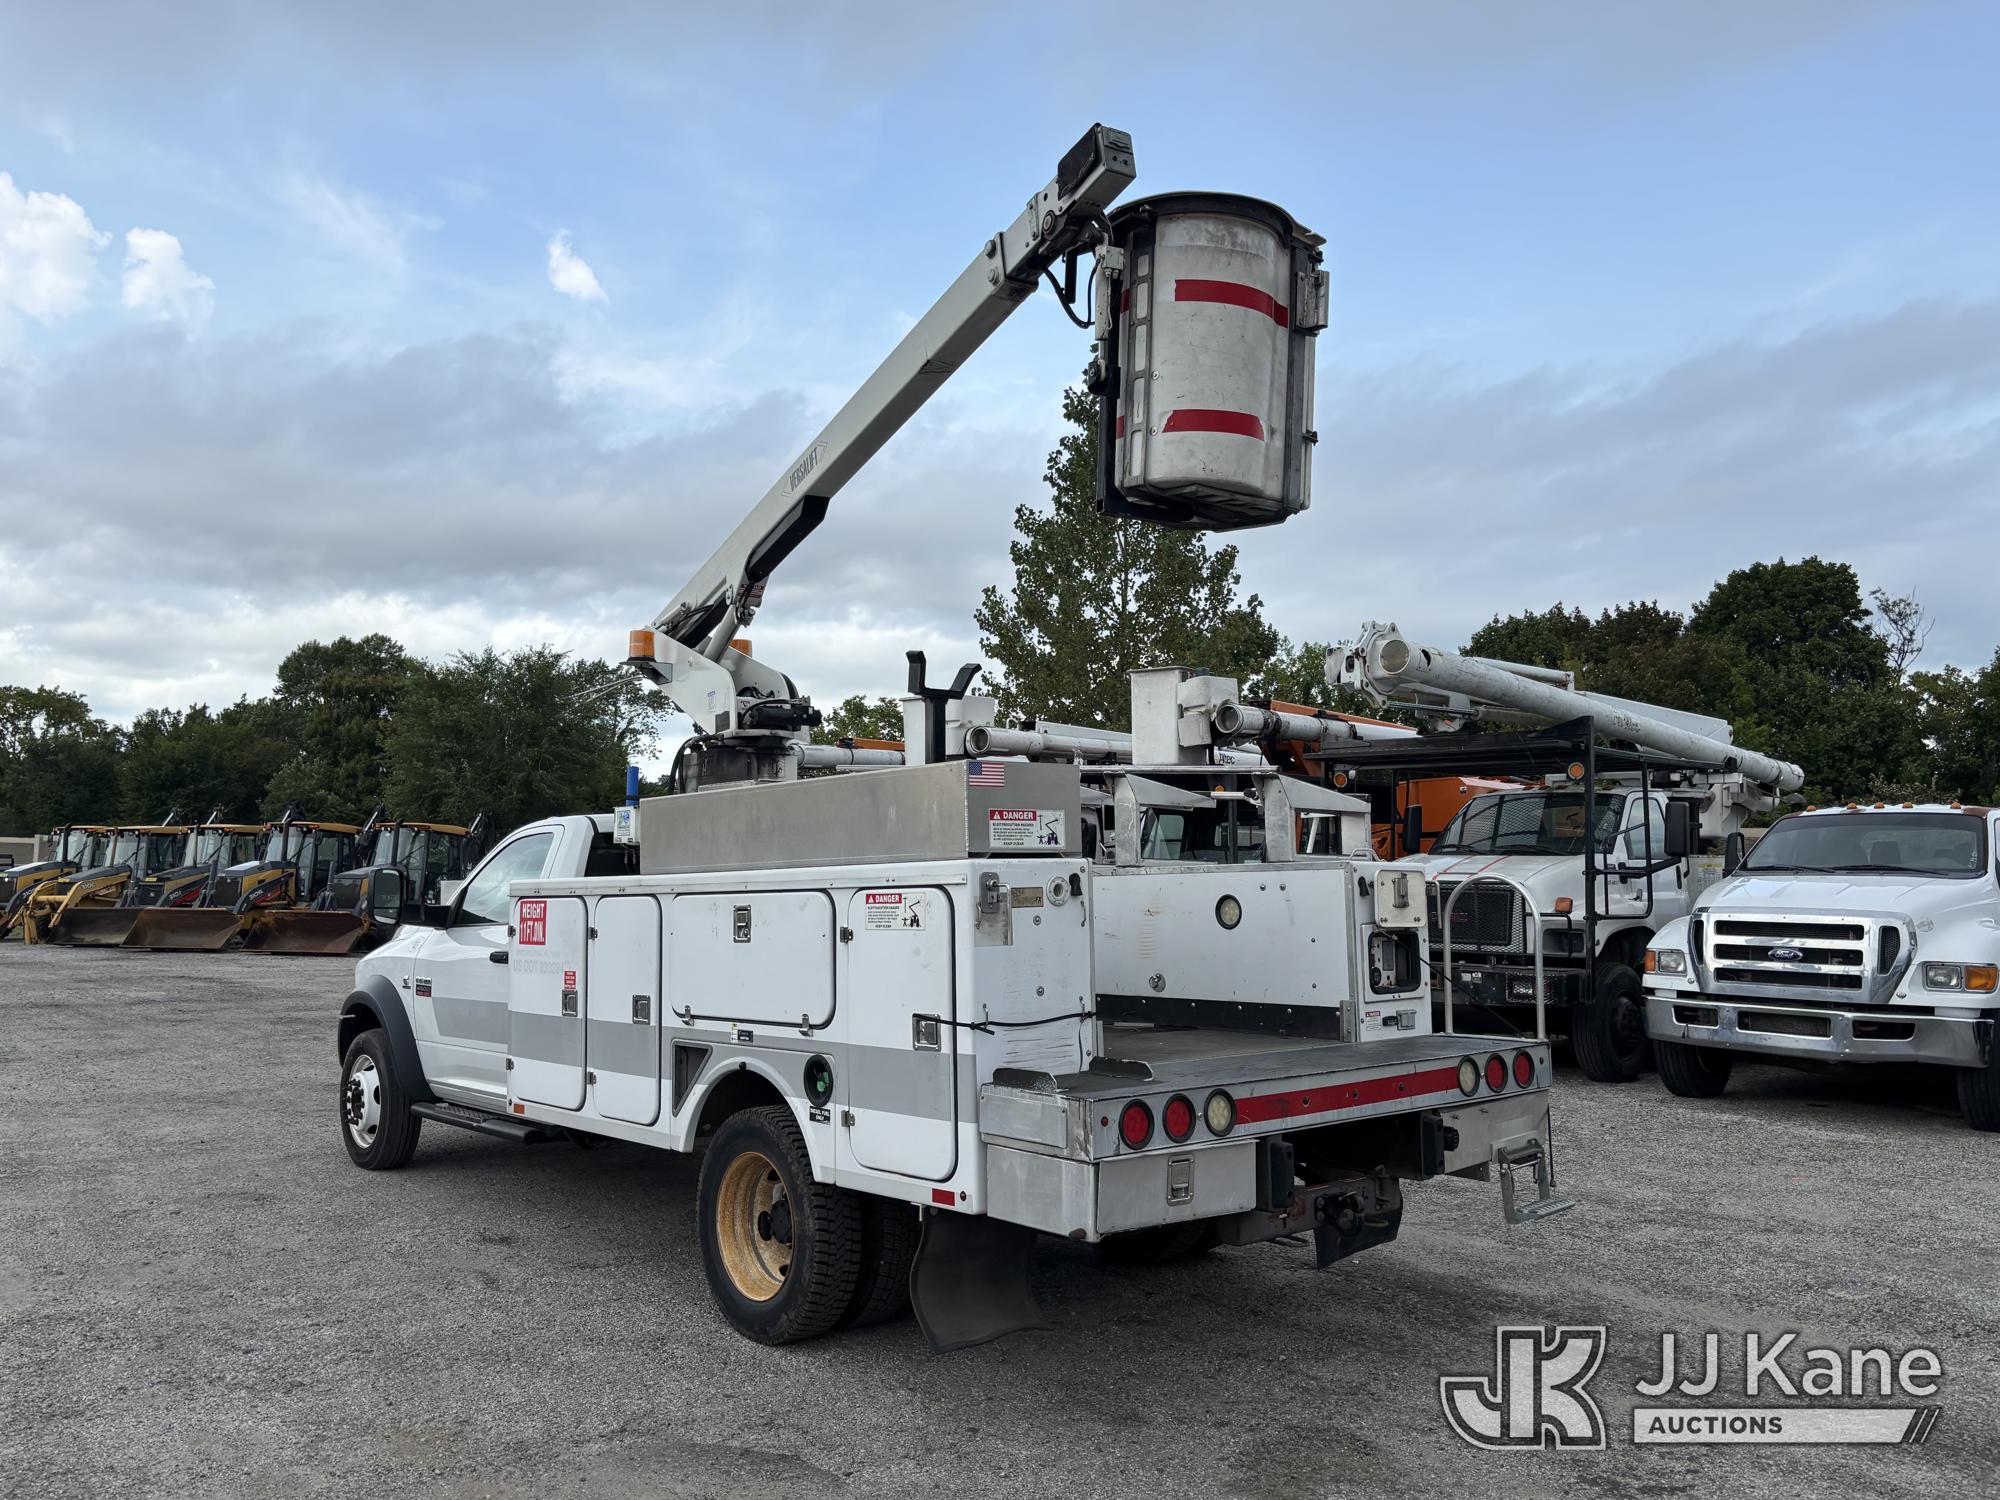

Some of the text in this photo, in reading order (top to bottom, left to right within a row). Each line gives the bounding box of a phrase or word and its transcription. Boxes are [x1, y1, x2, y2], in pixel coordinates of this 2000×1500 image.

[789, 447, 818, 492] VERSALIFT
[1003, 811, 1034, 820] DANGER
[875, 894, 900, 903] DANGER
[522, 903, 545, 919] HEIGHT
[1774, 950, 1794, 959] Ford
